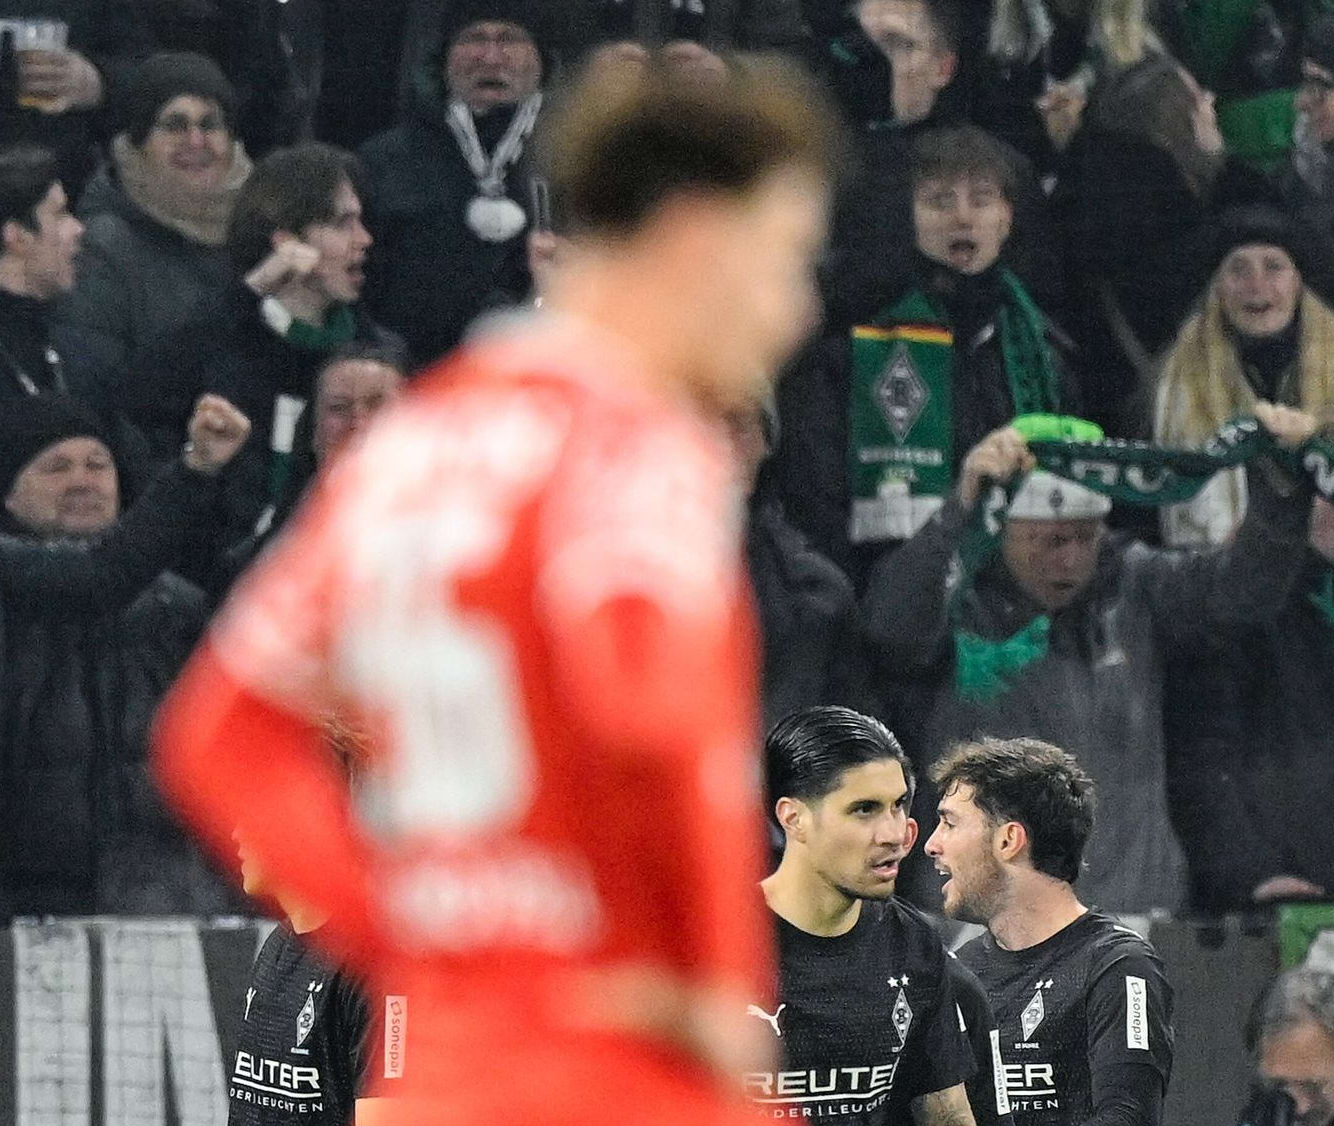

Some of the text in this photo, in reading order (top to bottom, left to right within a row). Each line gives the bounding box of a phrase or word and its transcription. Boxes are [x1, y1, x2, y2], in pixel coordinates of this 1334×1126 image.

[388, 1017, 402, 1074] sonepar
[1132, 996, 1142, 1046] sonepar
[743, 1063, 899, 1096] REUTE
